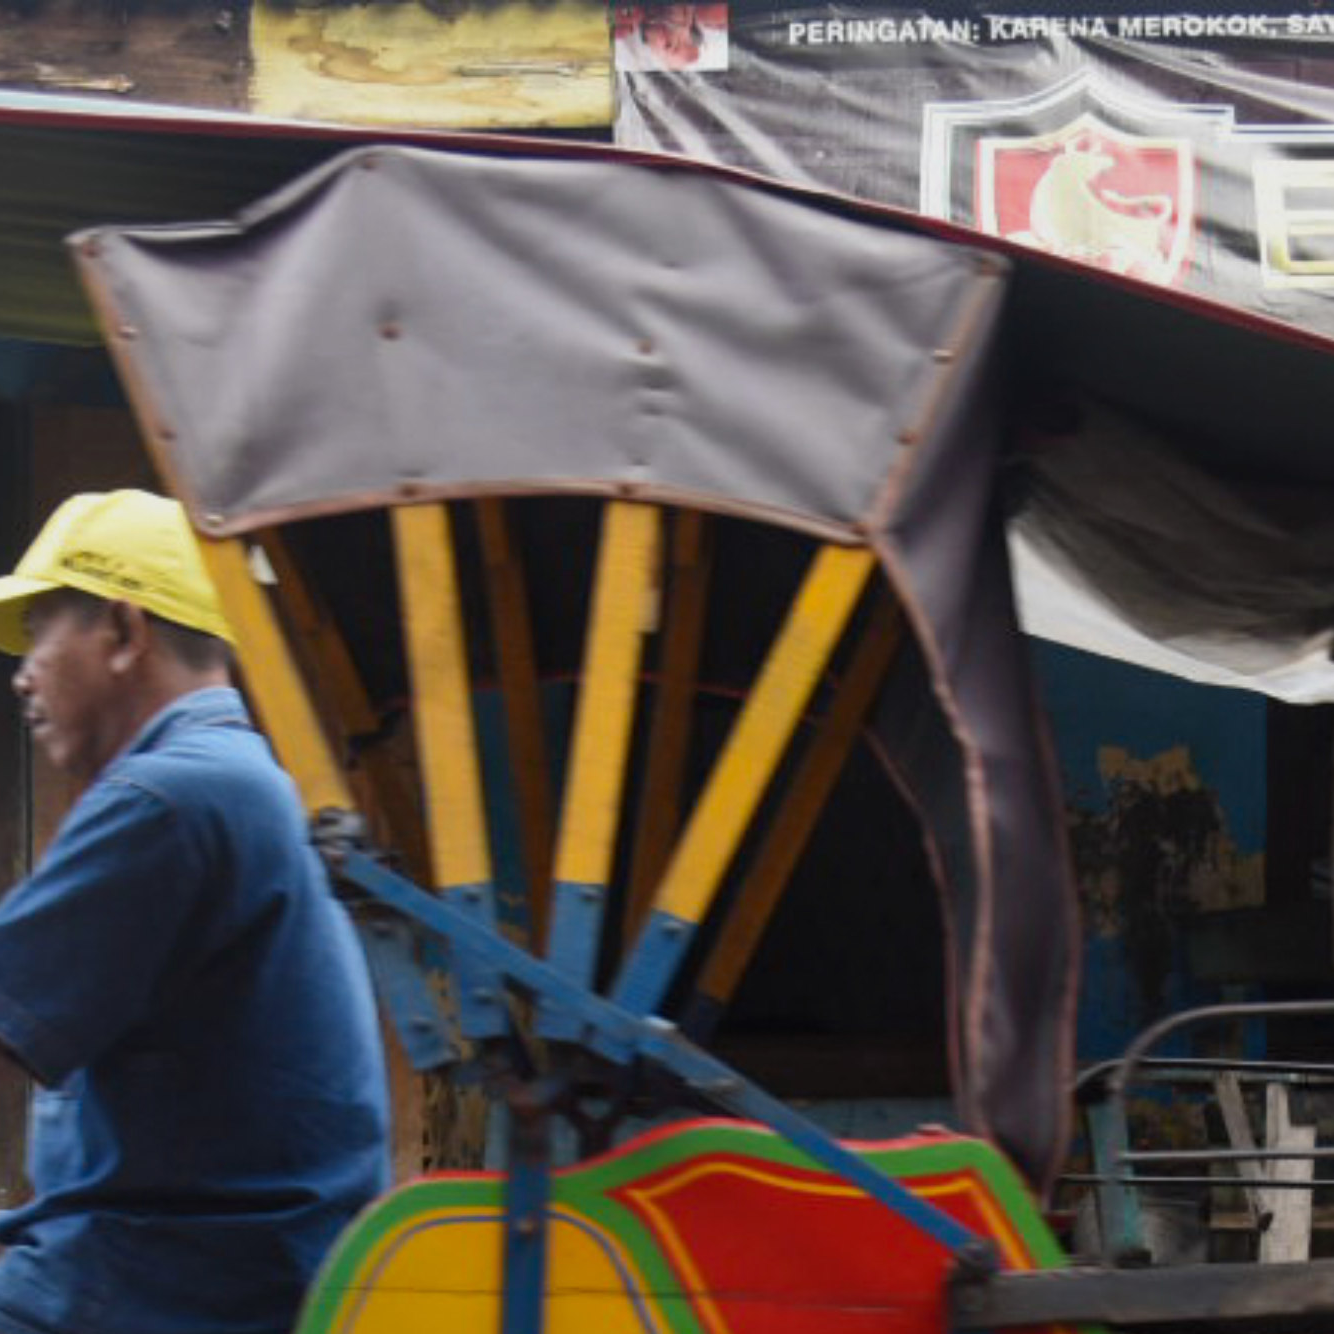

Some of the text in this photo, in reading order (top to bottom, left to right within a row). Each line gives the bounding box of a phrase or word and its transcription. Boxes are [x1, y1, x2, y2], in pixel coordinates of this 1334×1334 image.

[788, 19, 980, 45] PERINGATAN:
[989, 16, 1110, 40] KARENA
[1118, 14, 1277, 38] MEROKOK,
